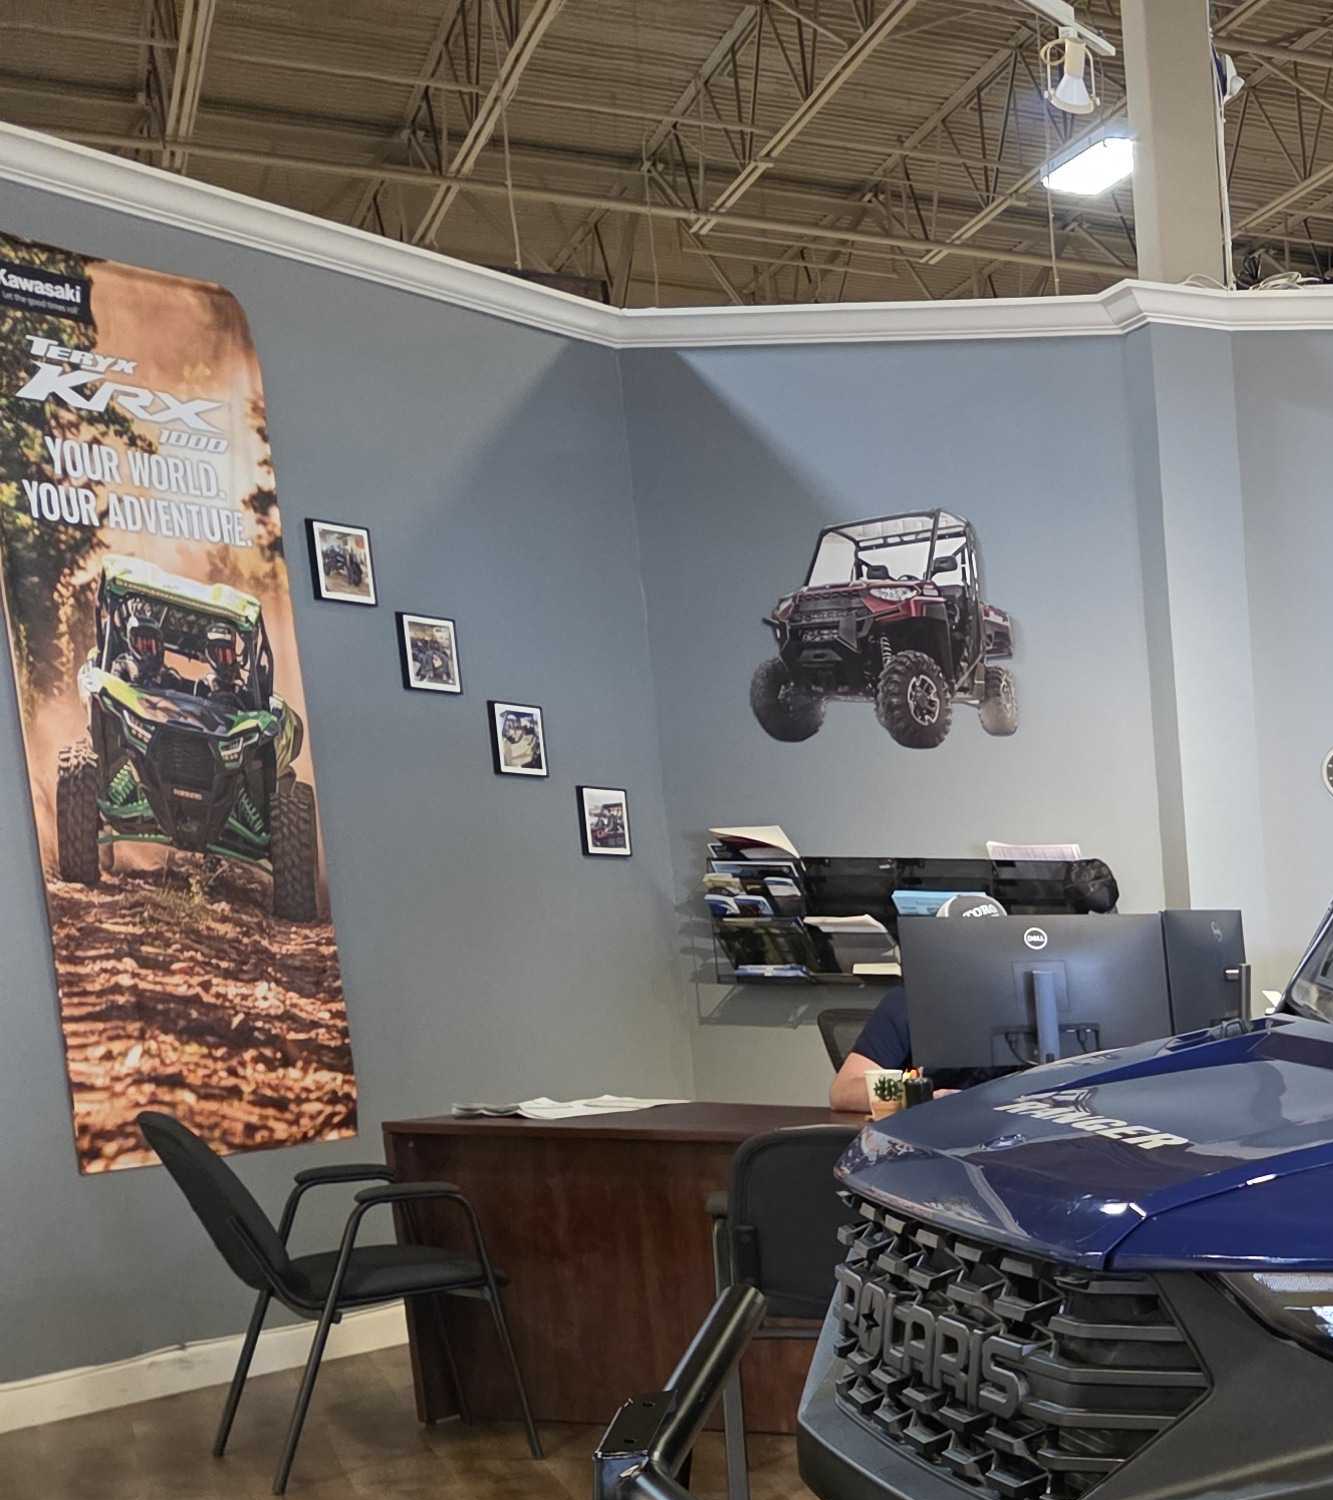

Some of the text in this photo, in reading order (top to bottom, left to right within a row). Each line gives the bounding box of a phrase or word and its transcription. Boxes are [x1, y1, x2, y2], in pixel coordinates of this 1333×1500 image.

[25, 334, 138, 375] TERYX
[15, 361, 225, 434] KRX
[44, 436, 226, 498] YOUR WORLD.
[159, 429, 230, 455] 1000
[22, 479, 253, 547] YOUR ADVENTURE.
[1026, 934, 1045, 942] DELL
[993, 1100, 1189, 1150] RANGER
[835, 1263, 1031, 1421] POLARIS
